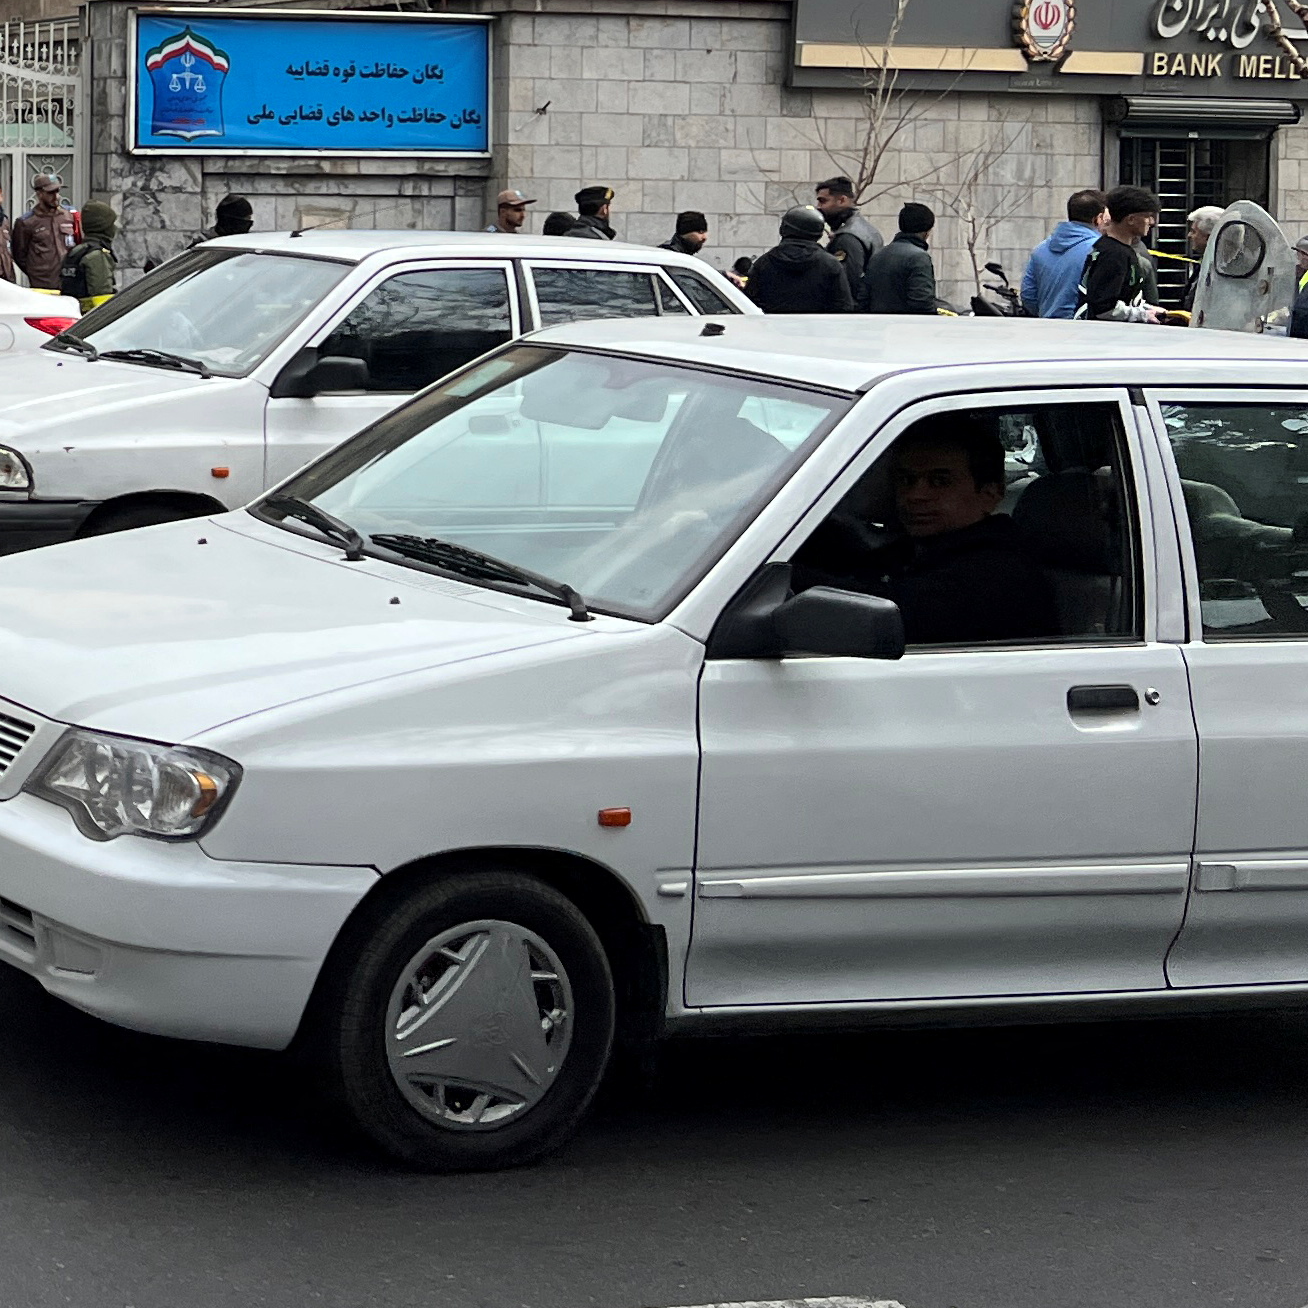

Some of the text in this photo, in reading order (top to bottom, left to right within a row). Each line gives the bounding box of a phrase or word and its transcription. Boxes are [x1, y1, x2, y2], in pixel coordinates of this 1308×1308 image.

[285, 59, 444, 84] یگان حفاظت قوه قضاییه
[1152, 53, 1223, 78] BANK
[246, 103, 482, 129] یگان حفاظت واحد های قضایی ملی
